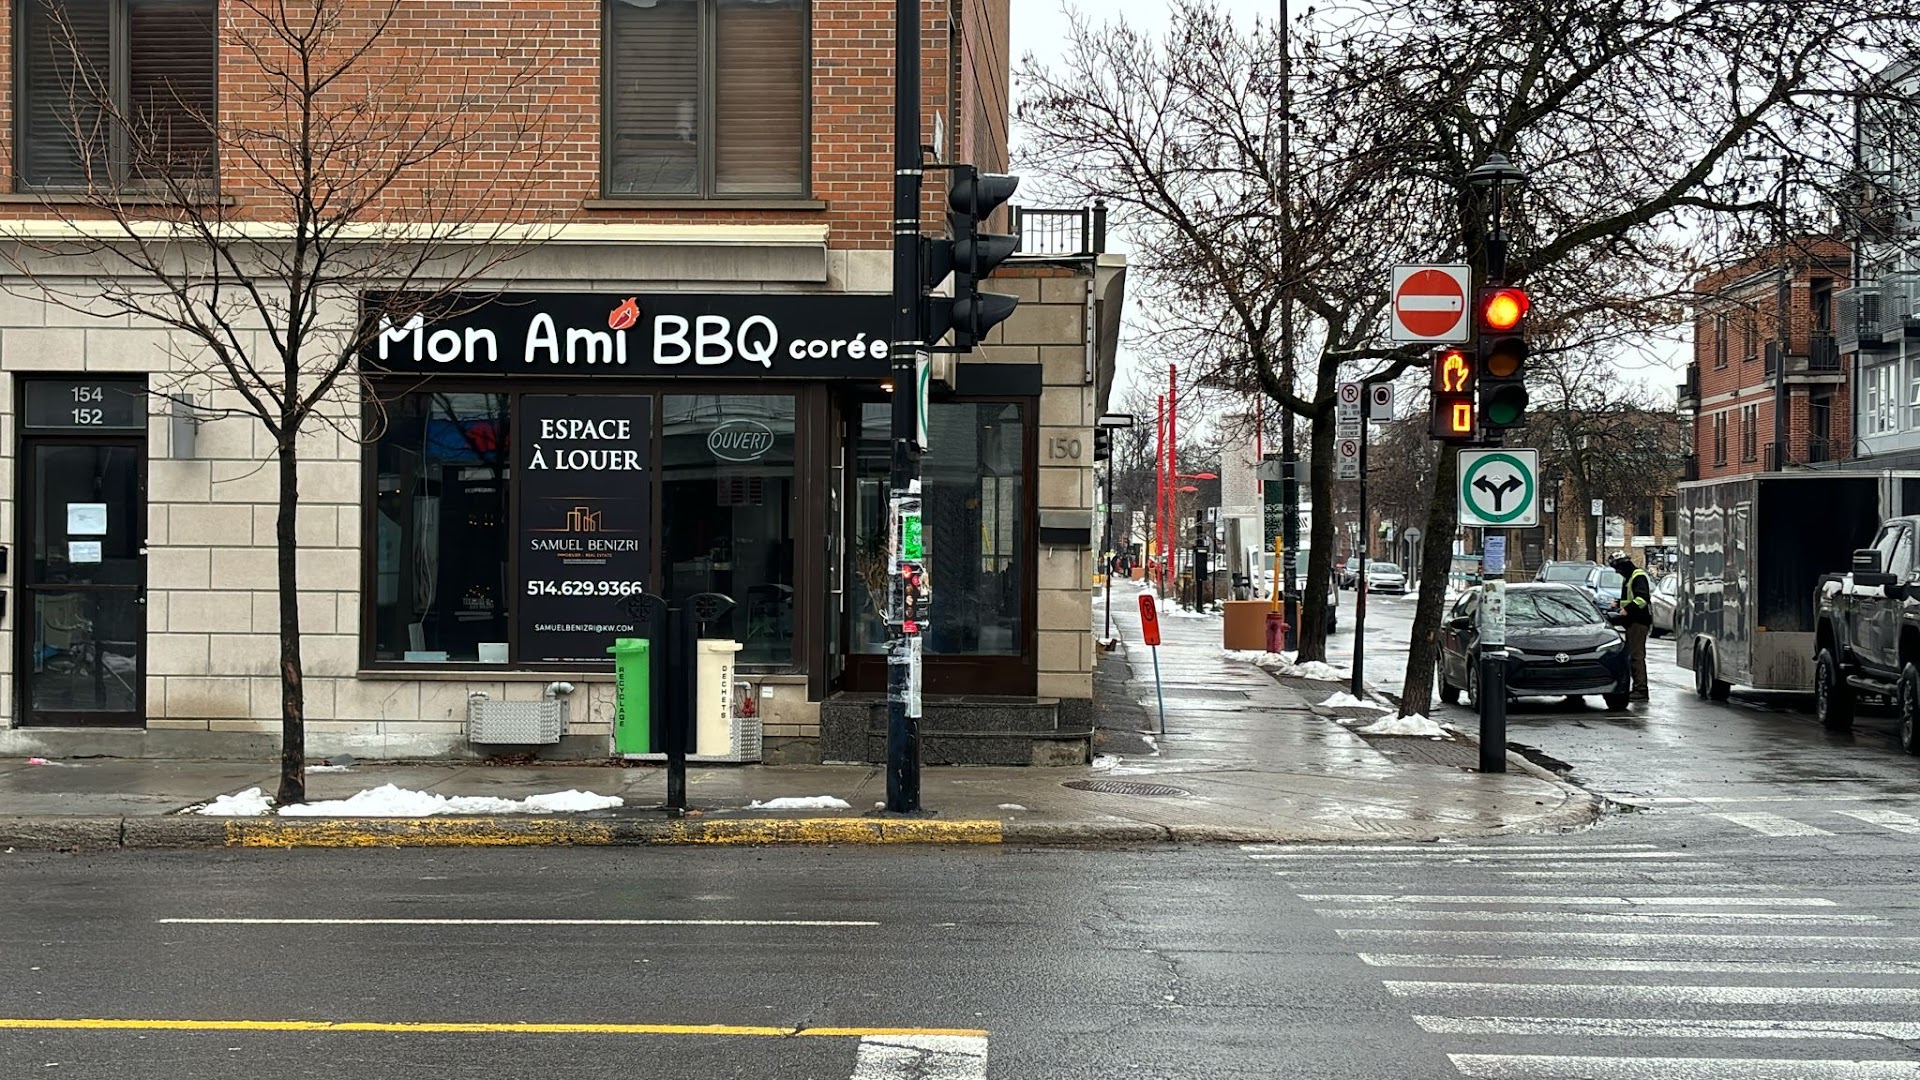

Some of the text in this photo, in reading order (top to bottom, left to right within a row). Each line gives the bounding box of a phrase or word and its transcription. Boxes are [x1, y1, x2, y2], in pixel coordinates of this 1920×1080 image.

[378, 311, 888, 369] Mon Ami BBQ corée
[71, 386, 103, 402] 154
[71, 409, 103, 425] 152
[540, 419, 631, 441] ESPACE
[711, 431, 771, 450] OUVERT
[1049, 437, 1082, 460] 150
[528, 443, 643, 471] À LOUER
[531, 539, 639, 552] SAMUEL BENIZRI
[527, 580, 643, 596] 514.629.9366
[534, 623, 634, 633] SAMUELBENIZRI@KW.COM
[618, 666, 626, 728] RECYCLAGE
[720, 665, 728, 719] DECHETS
